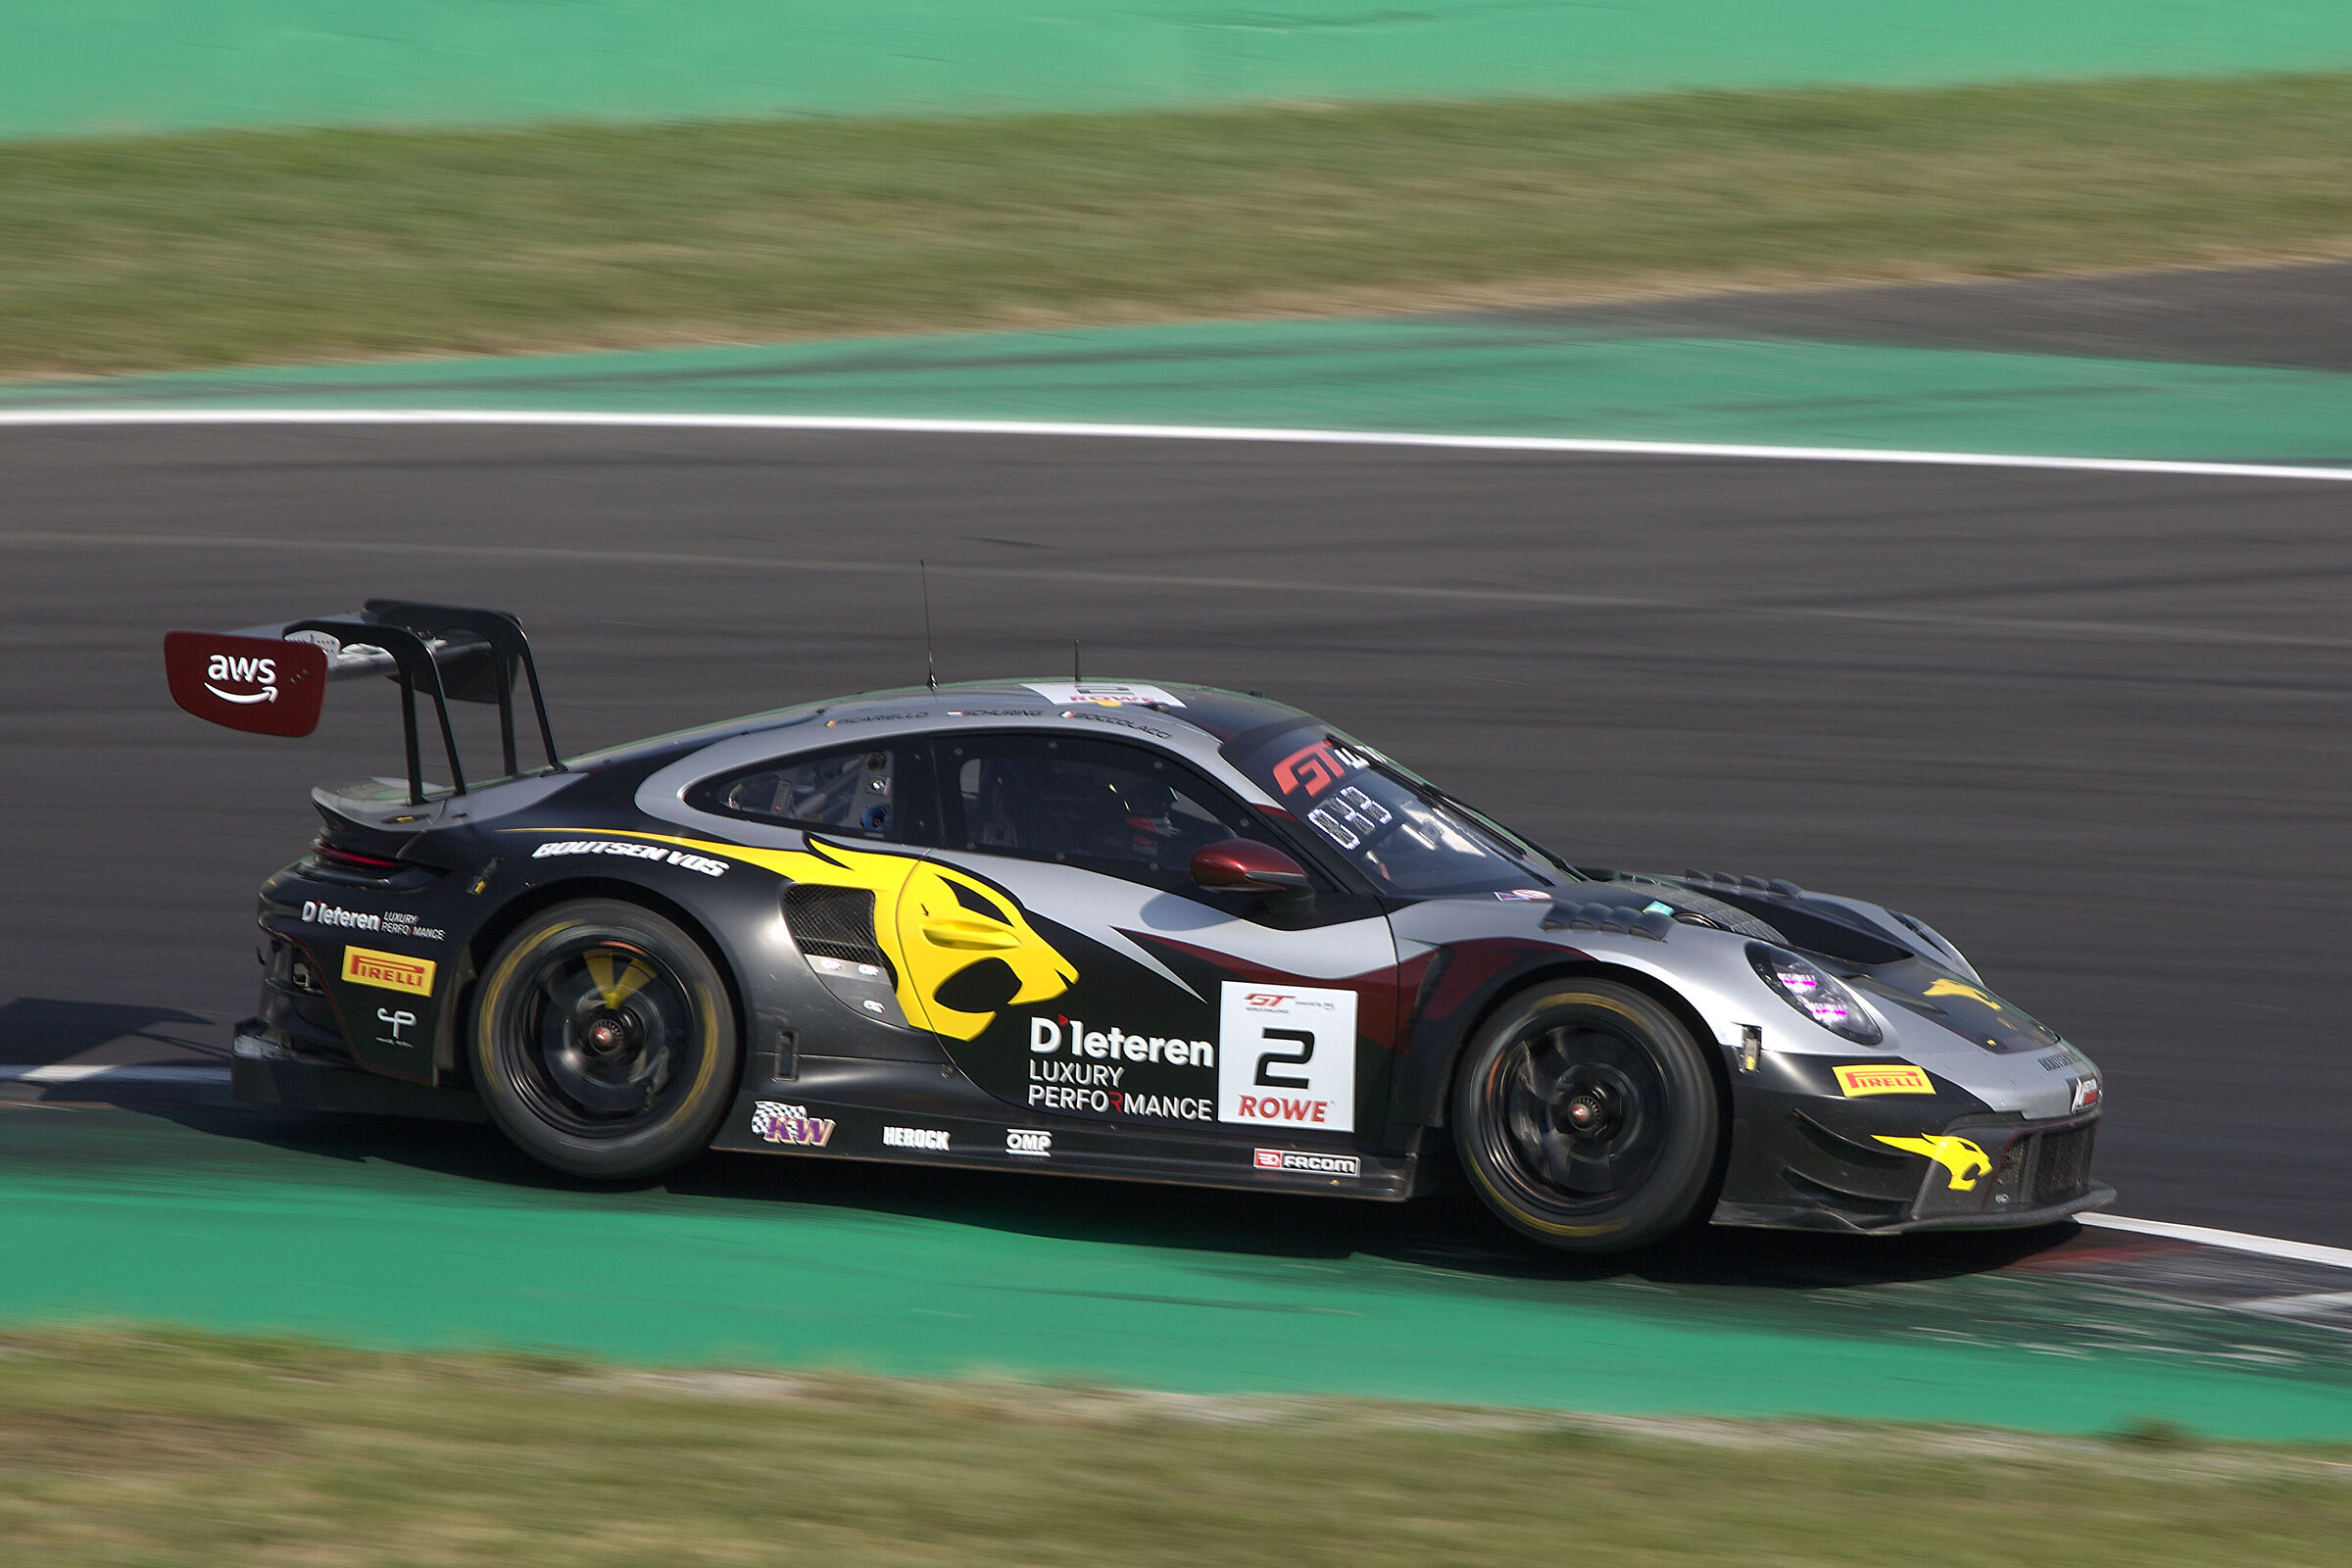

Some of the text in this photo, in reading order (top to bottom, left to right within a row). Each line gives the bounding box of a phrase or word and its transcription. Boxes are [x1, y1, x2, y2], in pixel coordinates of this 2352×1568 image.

[207, 654, 277, 686] aws
[1273, 739, 1346, 797] GT
[531, 841, 670, 861] BOUTSEN
[383, 910, 419, 926] LUXURY
[351, 955, 424, 987] PIRELLI
[1253, 1027, 1315, 1089] 2
[1029, 1059, 1125, 1088] LUXURY
[1844, 1070, 1923, 1089] PIRELLI
[1028, 1084, 1213, 1121] PERFORMANCE
[1239, 1094, 1328, 1123] ROWE
[883, 1127, 951, 1152] HEROCK
[1006, 1131, 1052, 1152] OMP
